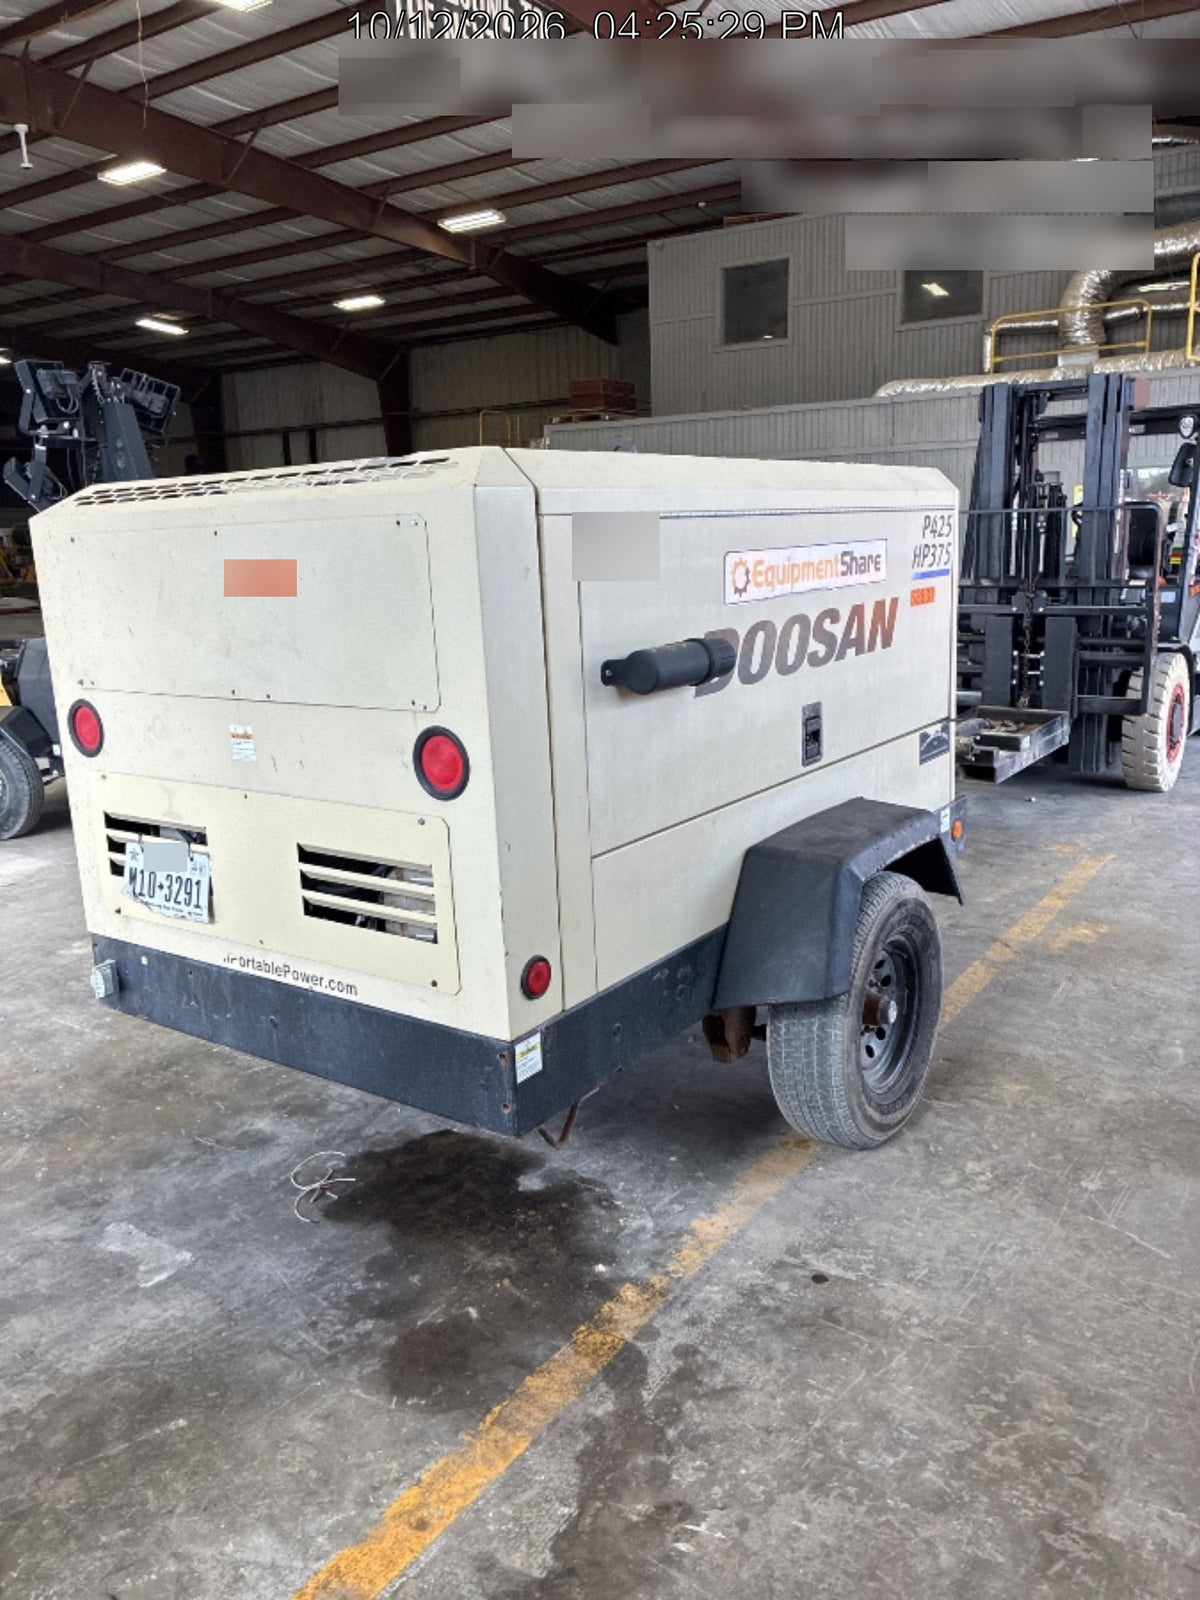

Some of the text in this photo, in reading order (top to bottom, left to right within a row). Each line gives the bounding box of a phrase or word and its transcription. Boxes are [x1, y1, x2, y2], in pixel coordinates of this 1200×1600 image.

[922, 514, 952, 539] P425
[911, 543, 951, 569] HP375
[752, 550, 882, 591] EquipmentShare
